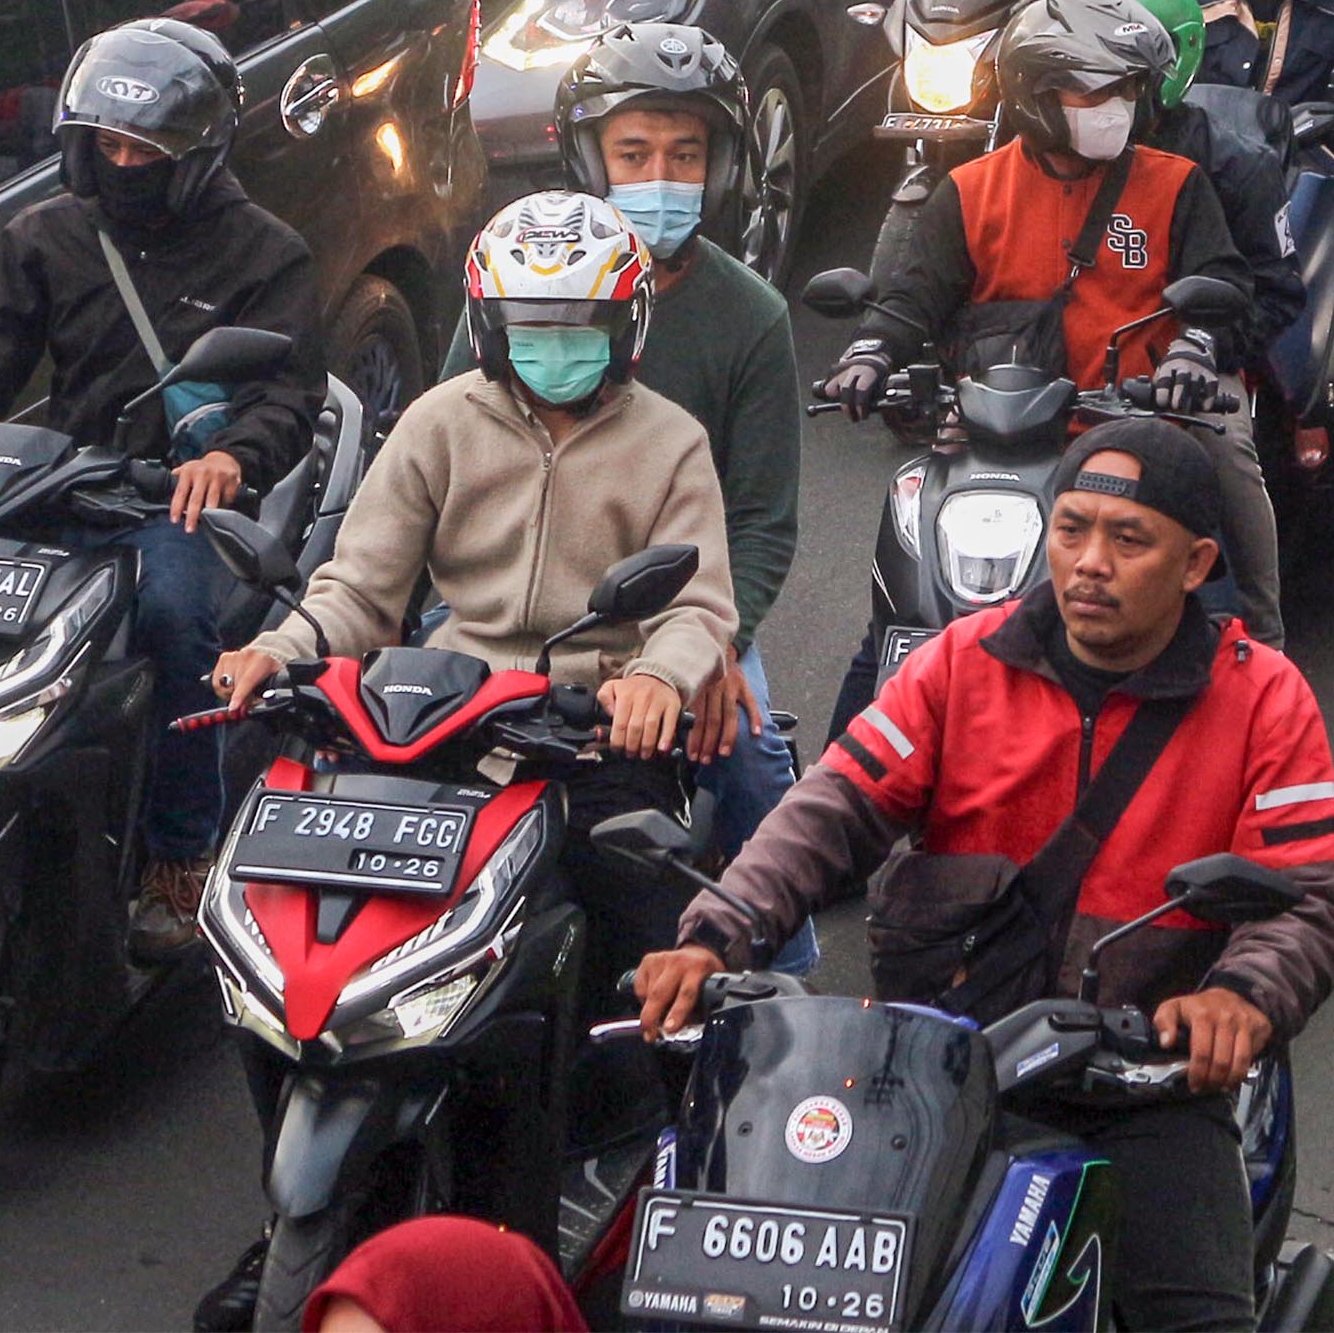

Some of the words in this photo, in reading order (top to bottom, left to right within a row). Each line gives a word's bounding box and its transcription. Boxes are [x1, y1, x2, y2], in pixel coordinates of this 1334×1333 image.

[1108, 213, 1148, 268] SB
[969, 473, 1020, 483] HONDA
[893, 639, 911, 663] F
[382, 684, 433, 696] HONDA
[257, 802, 281, 833] F
[295, 806, 375, 842] 2948
[393, 813, 459, 849] FGG
[1008, 1174, 1051, 1247] YAMAHA
[648, 1208, 676, 1252] F
[703, 1214, 805, 1265] 6606
[816, 1226, 899, 1275] AAB
[643, 1291, 698, 1314] YAMAHA
[759, 1315, 823, 1331] SEMAKIN
